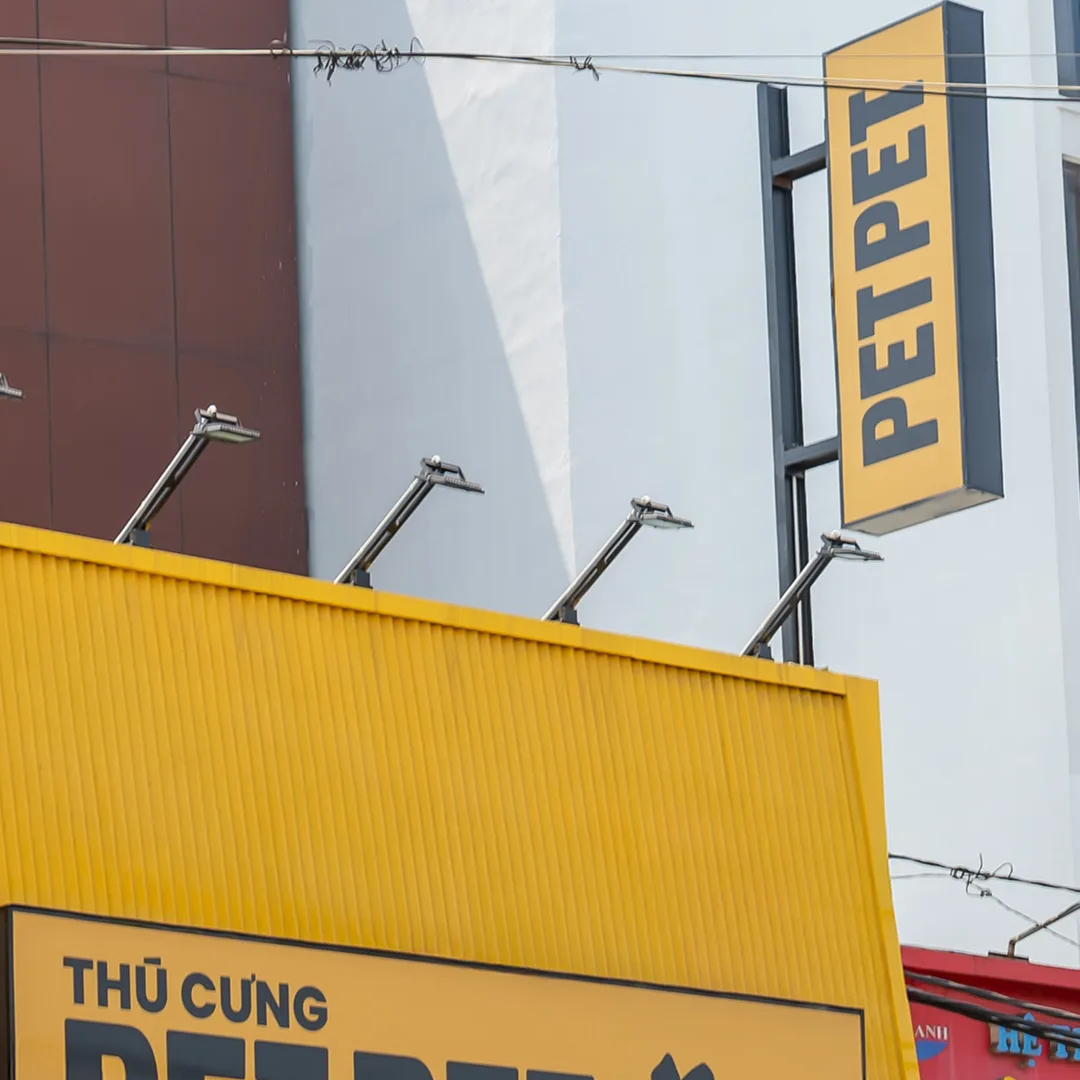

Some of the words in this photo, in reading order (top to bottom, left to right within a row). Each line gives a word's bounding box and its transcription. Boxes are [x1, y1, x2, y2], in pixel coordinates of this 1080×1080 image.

[848, 79, 930, 272] PET
[857, 276, 939, 467] PET
[180, 972, 328, 1031] CƯNG
